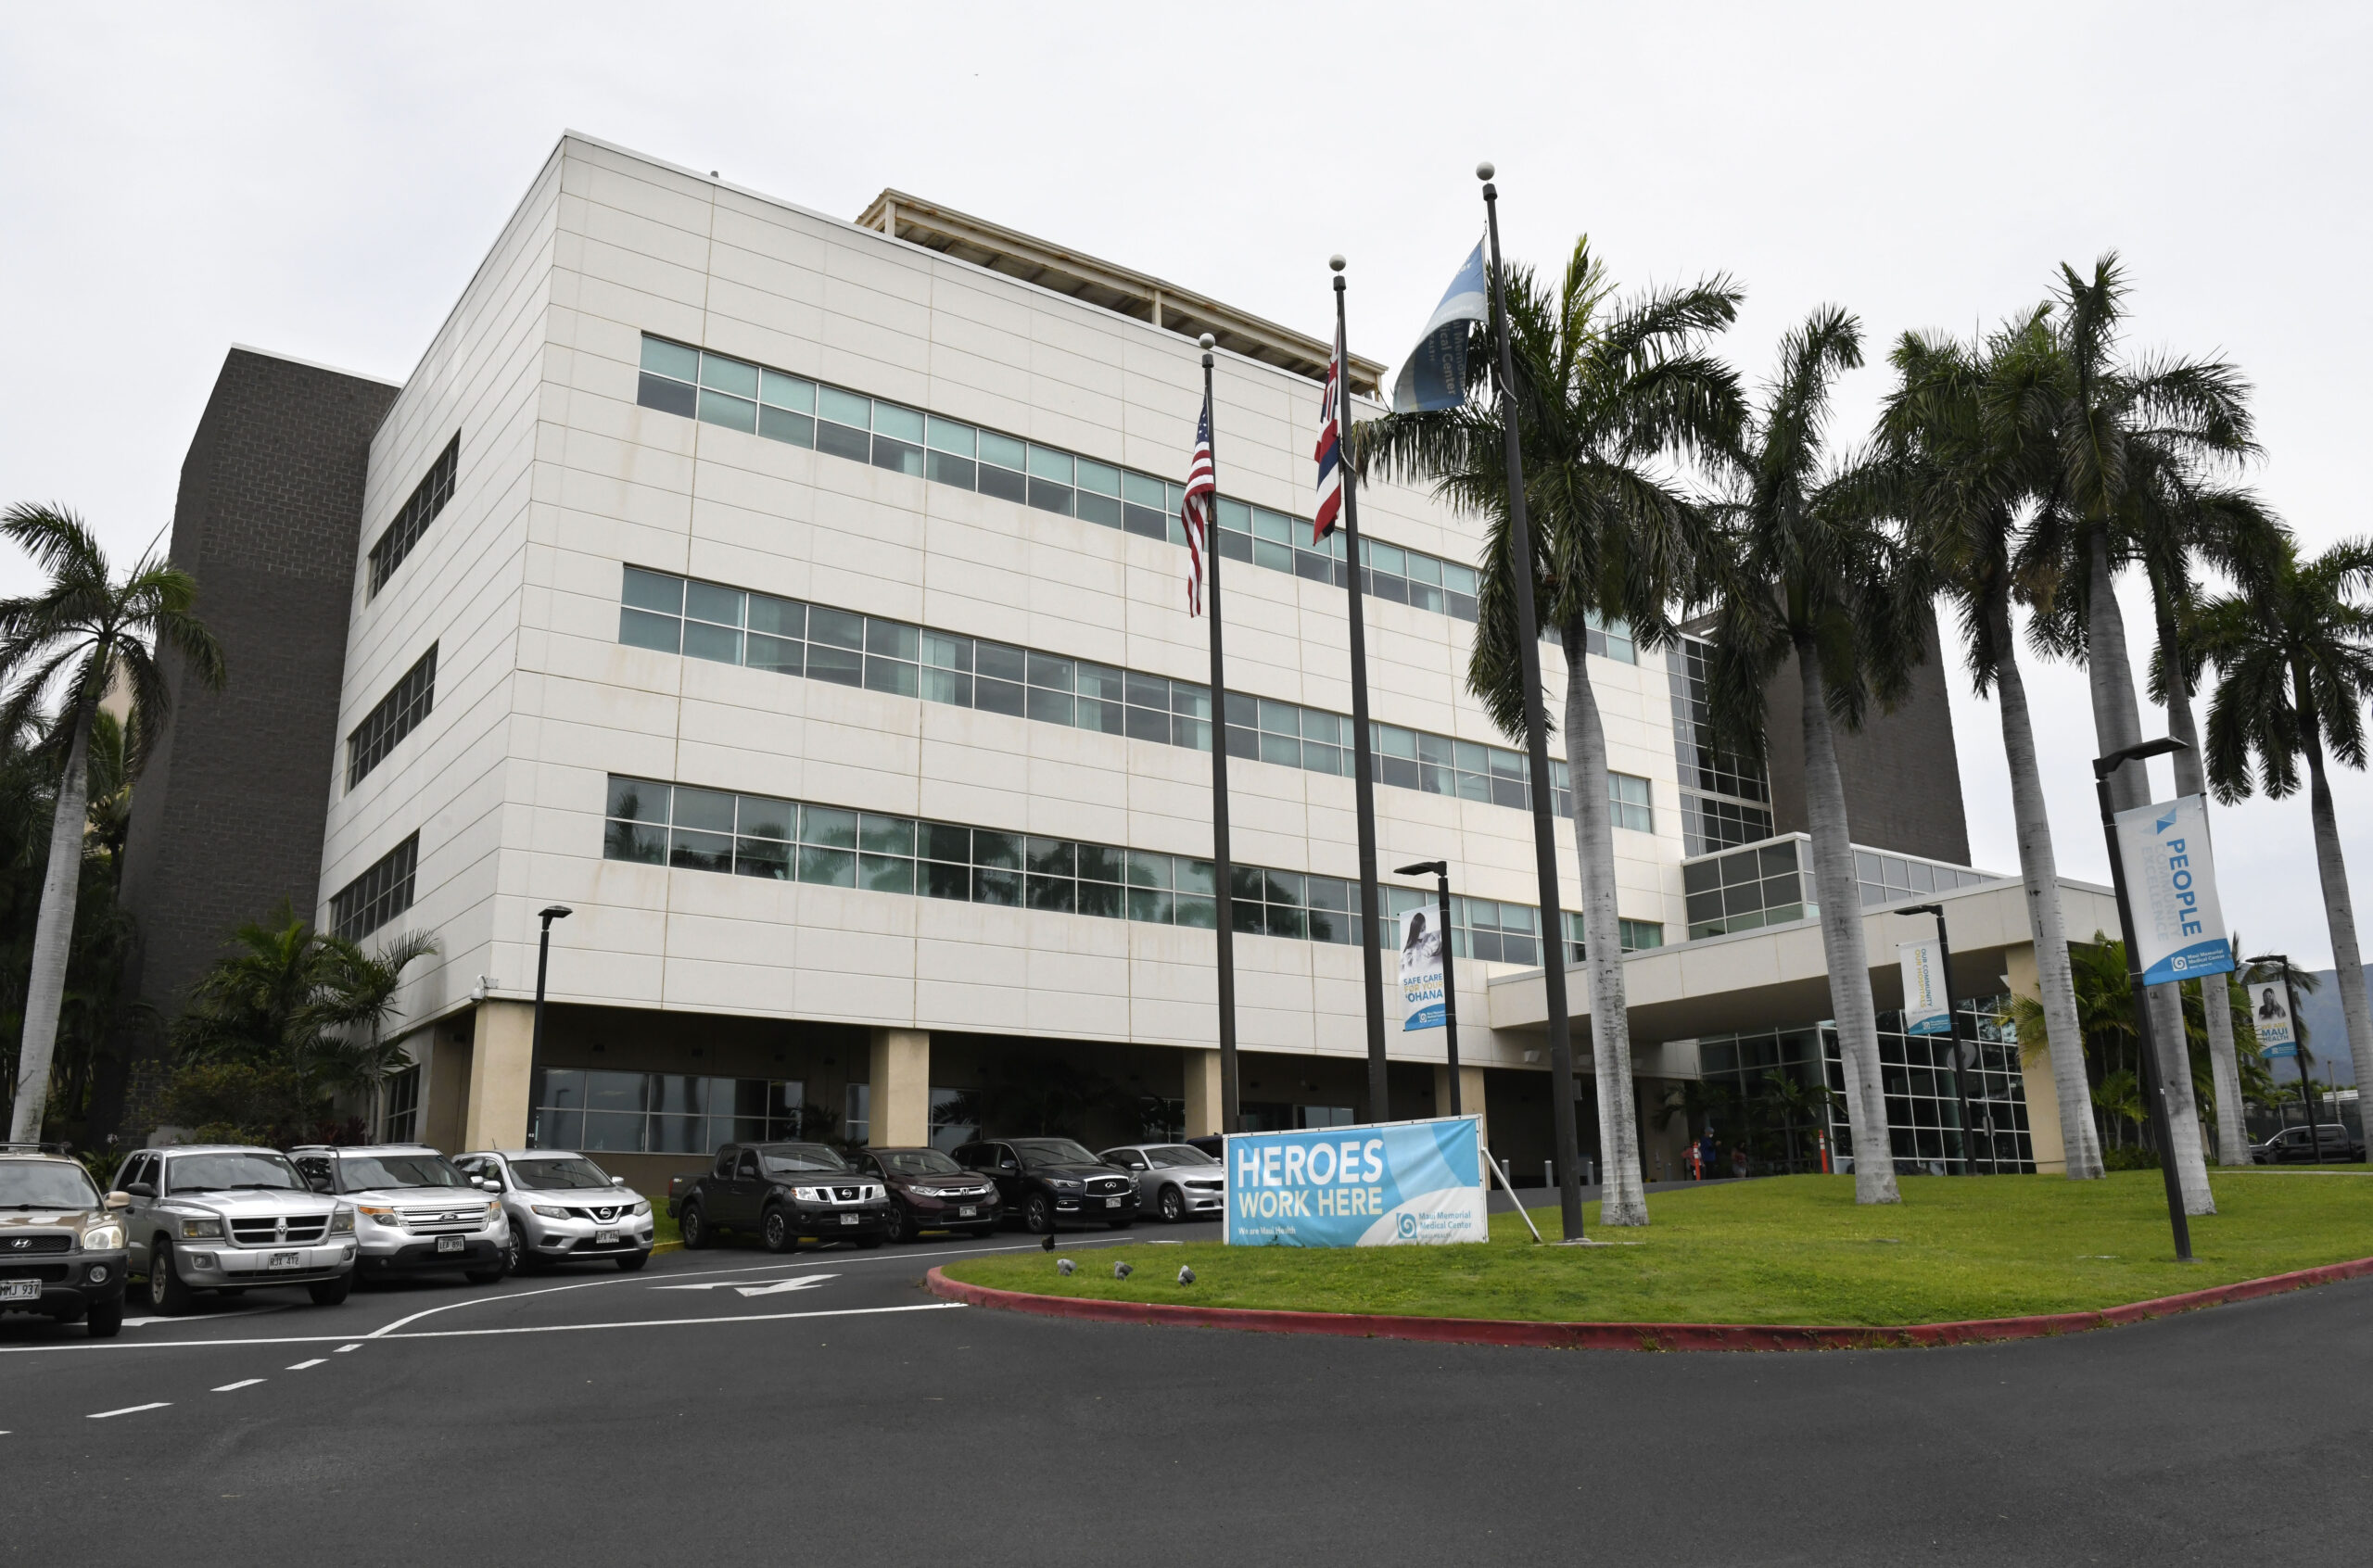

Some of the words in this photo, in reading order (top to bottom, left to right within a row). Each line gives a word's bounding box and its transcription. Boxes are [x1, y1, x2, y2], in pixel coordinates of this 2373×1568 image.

[1442, 353, 1456, 395] Center
[2141, 846, 2169, 942] EXCELLENCE
[2155, 843, 2181, 937] COMMUNITY
[2166, 838, 2202, 937] PEOPLE
[1403, 976, 1421, 986] SAFE
[1423, 973, 1443, 983] CARE
[1404, 983, 1420, 993] FOR
[1422, 980, 1443, 991] YOUR
[1923, 964, 1934, 1007] COMMUNITY
[2262, 1027, 2288, 1037] MAUI
[1237, 1139, 1384, 1188] HEROES
[1238, 1190, 1311, 1219] WORK
[1318, 1187, 1383, 1217] HERE
[1418, 1212, 1436, 1220] Maui
[1437, 1210, 1471, 1220] Memorial
[1419, 1221, 1446, 1231] Medical
[1448, 1220, 1472, 1230] Center
[1237, 1226, 1249, 1235] We
[1260, 1225, 1275, 1235] Maui
[1275, 1225, 1296, 1235] Health
[22, 1283, 39, 1295] 937
